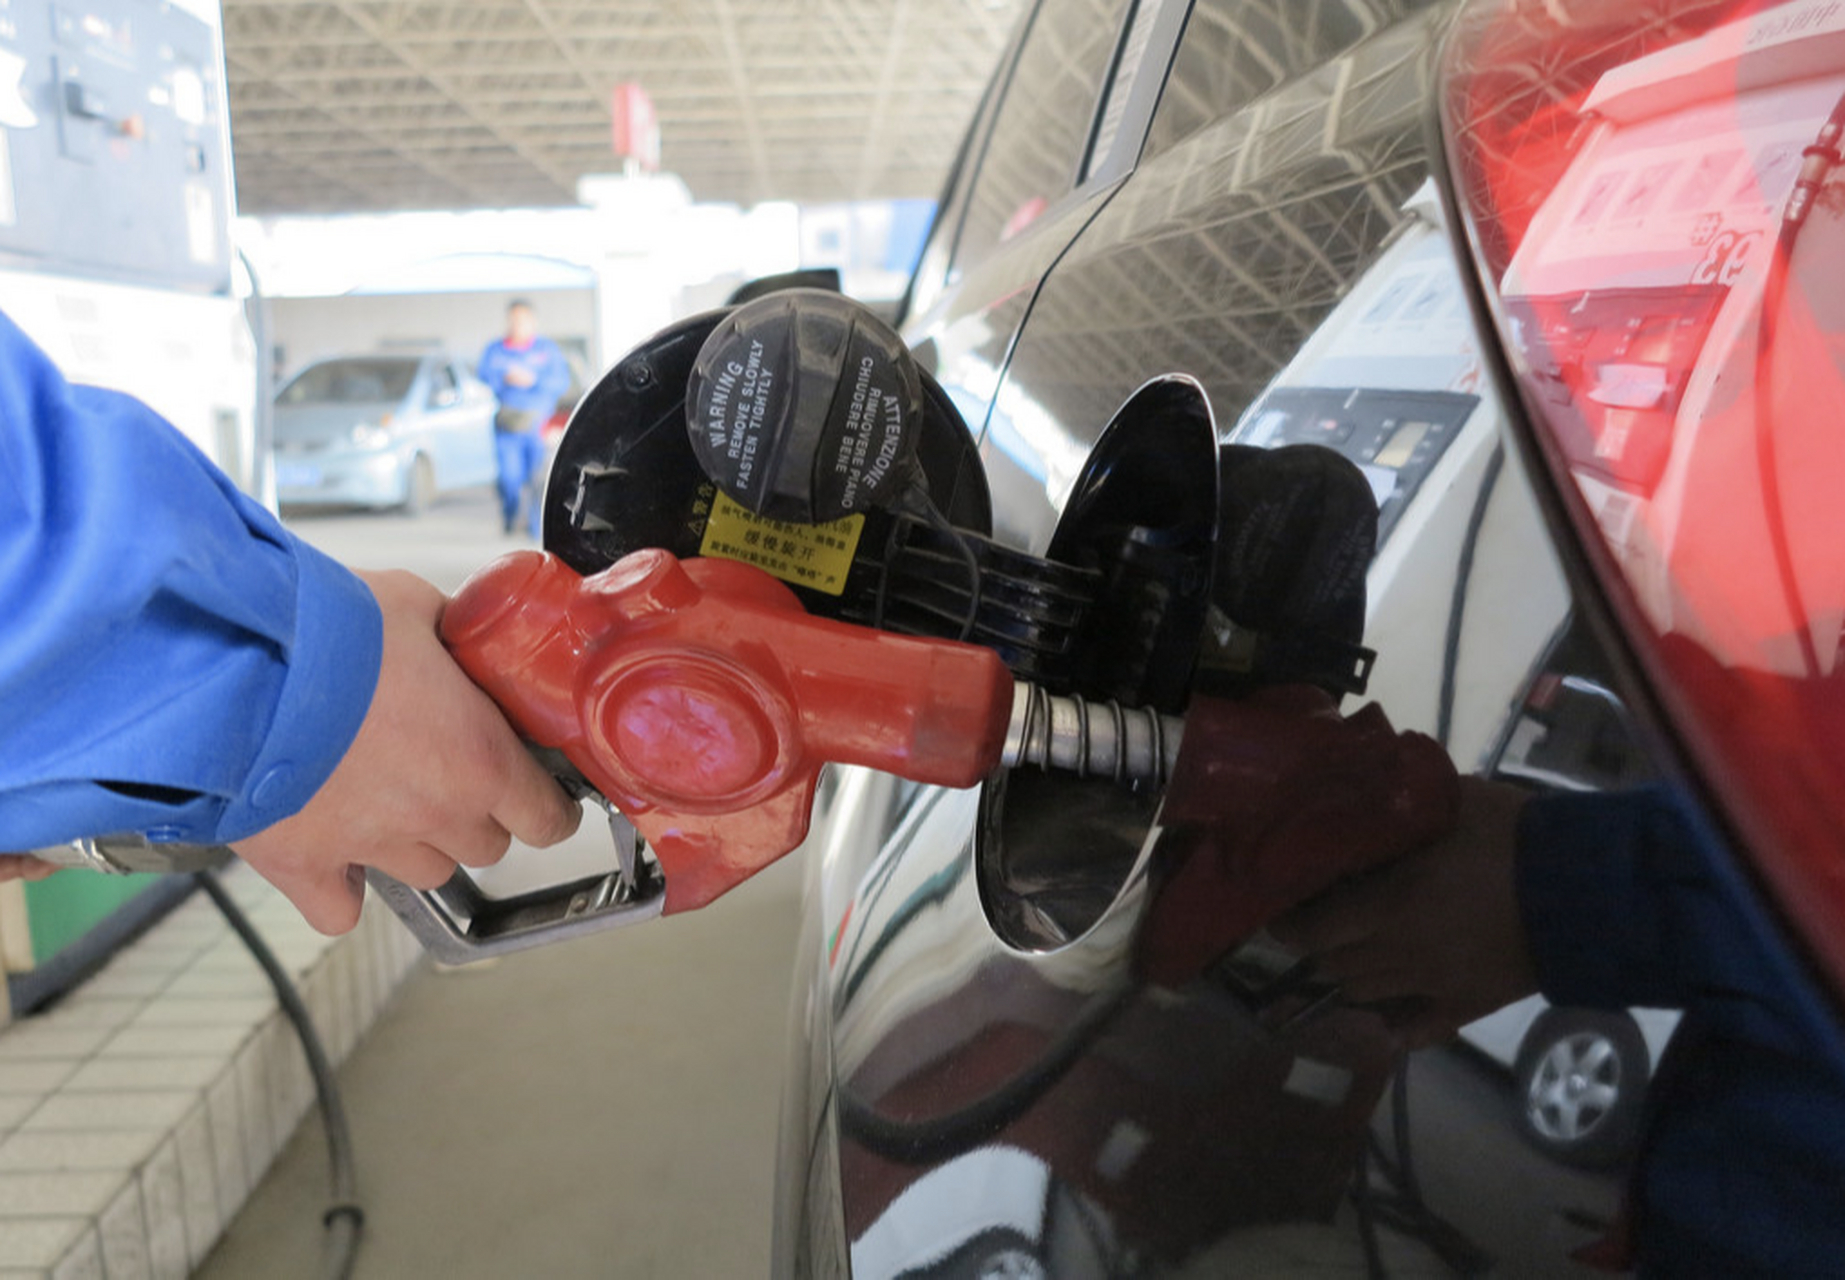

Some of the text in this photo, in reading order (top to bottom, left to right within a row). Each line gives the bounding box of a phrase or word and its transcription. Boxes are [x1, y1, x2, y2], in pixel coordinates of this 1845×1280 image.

[709, 361, 743, 447] WARNING
[728, 340, 763, 459] REMOVE SLOWLY
[736, 368, 773, 489] FASTEN TIGHTLY
[835, 357, 874, 473] CHIUDERE BENE
[841, 387, 881, 509] RIMUOVERE PIANO
[862, 396, 900, 489] ATTENZIONE
